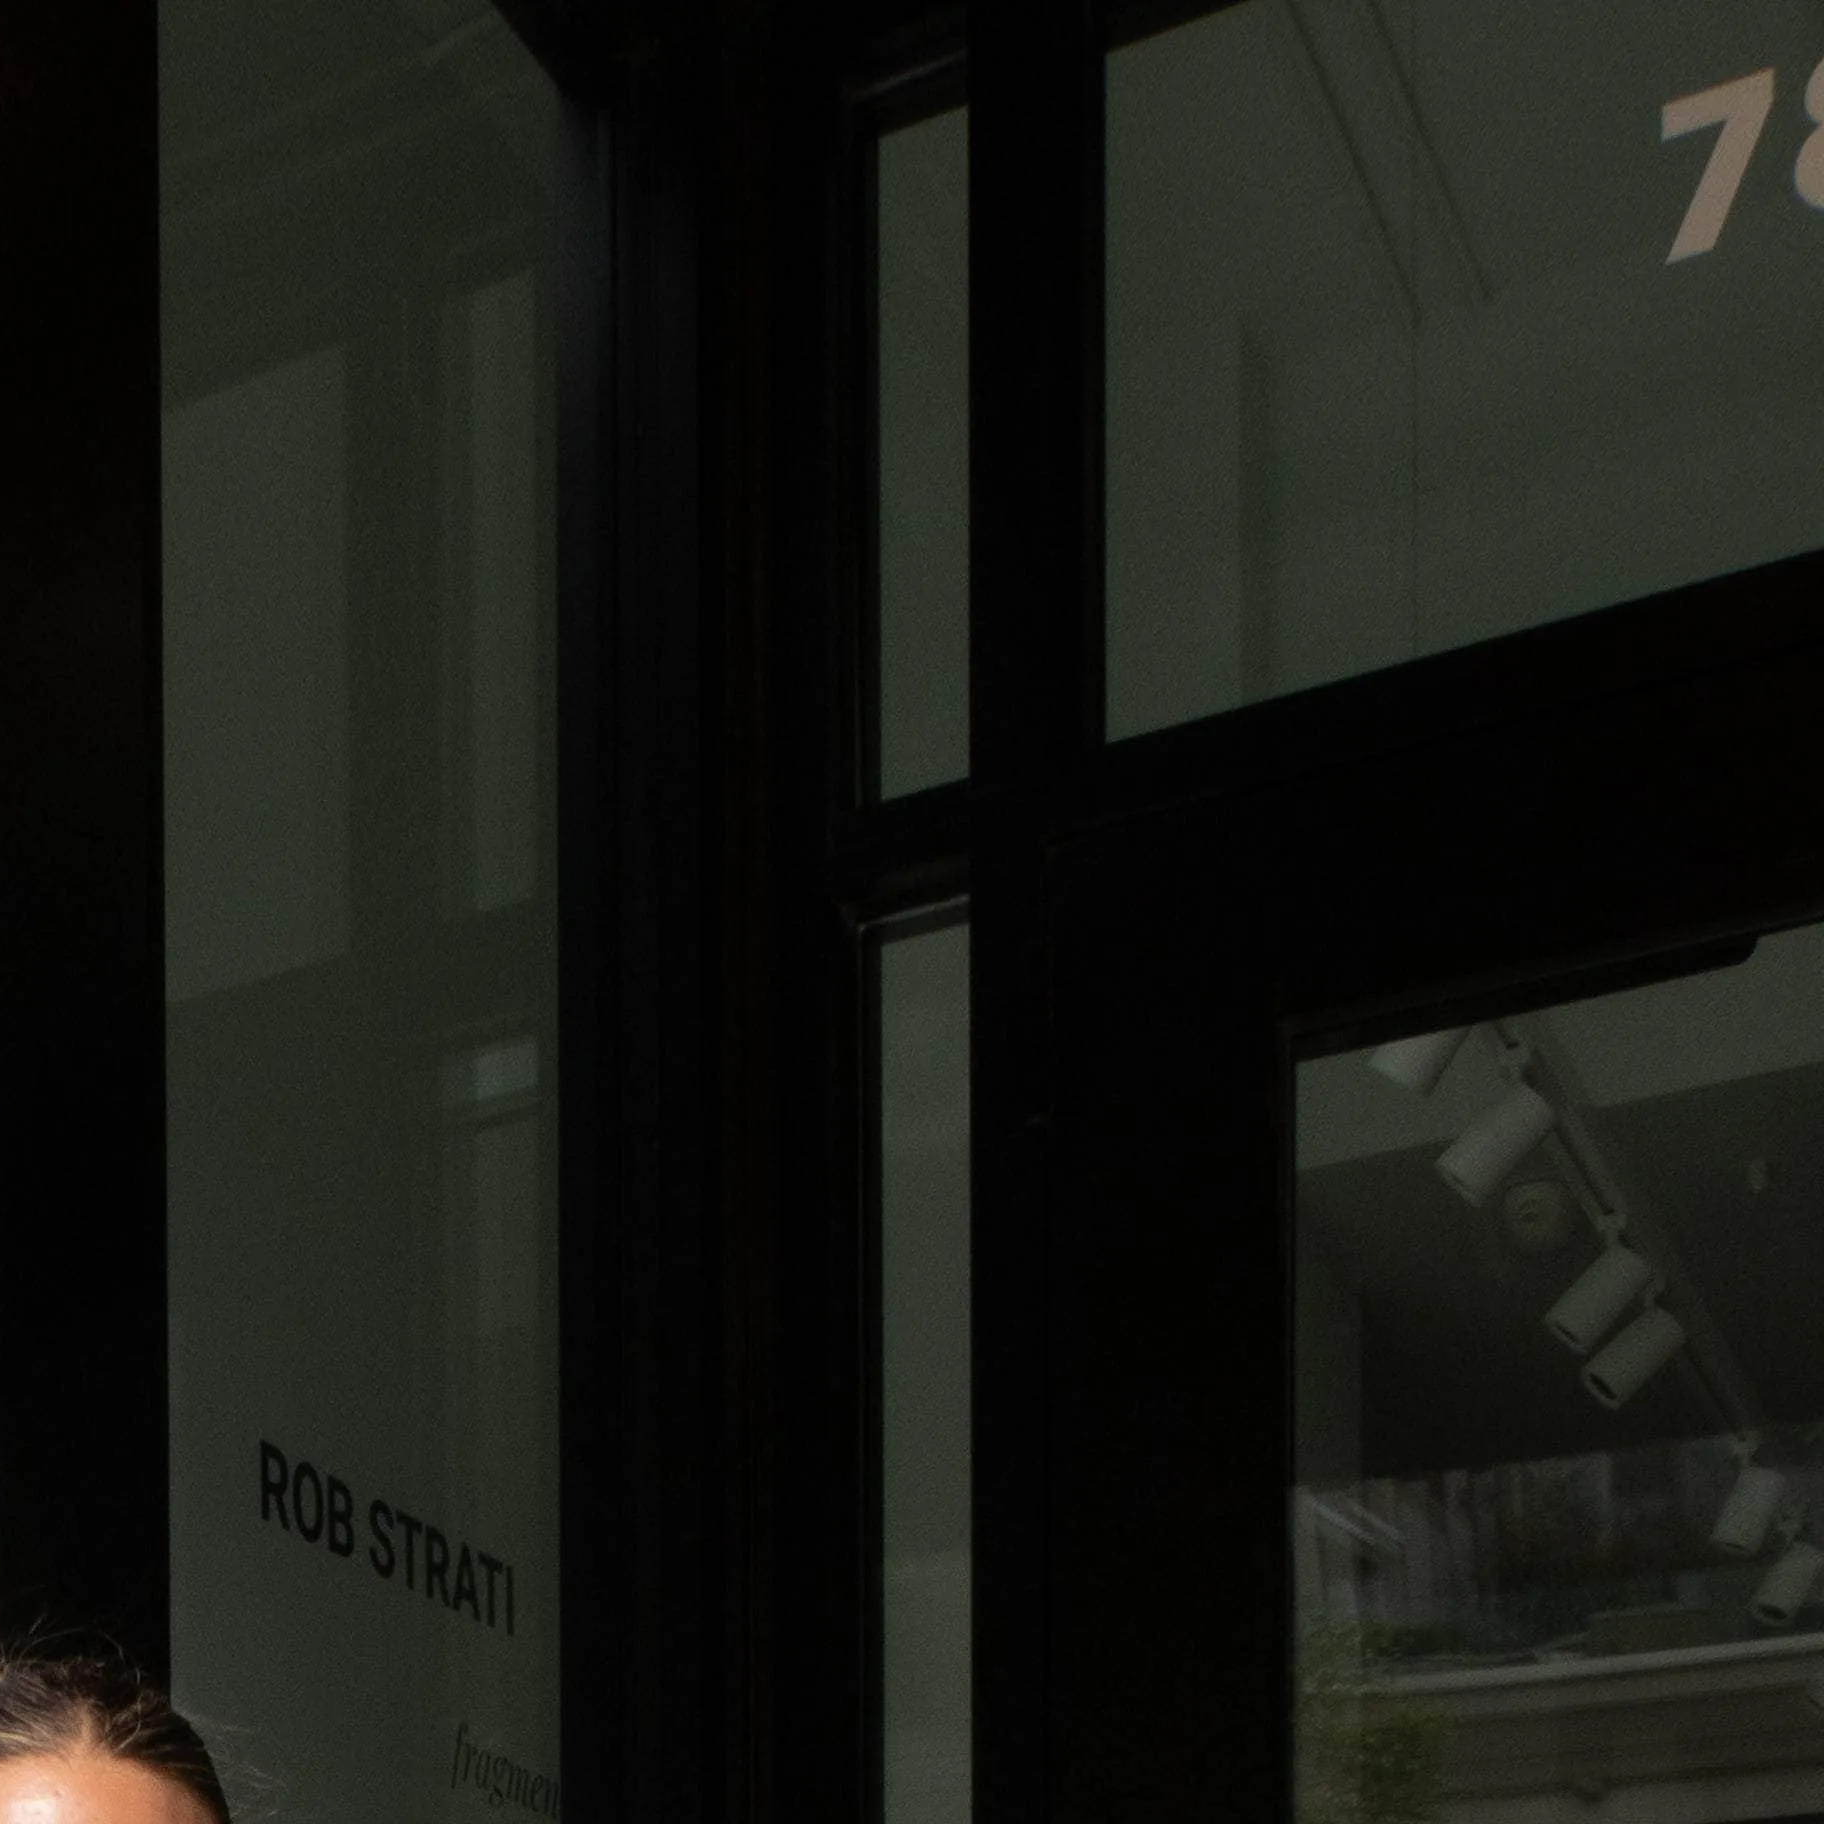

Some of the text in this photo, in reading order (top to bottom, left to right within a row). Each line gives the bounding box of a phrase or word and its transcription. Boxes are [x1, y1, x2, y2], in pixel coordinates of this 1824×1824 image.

[1661, 57, 1824, 265] 7
[259, 1440, 516, 1636] ROB STRATI
